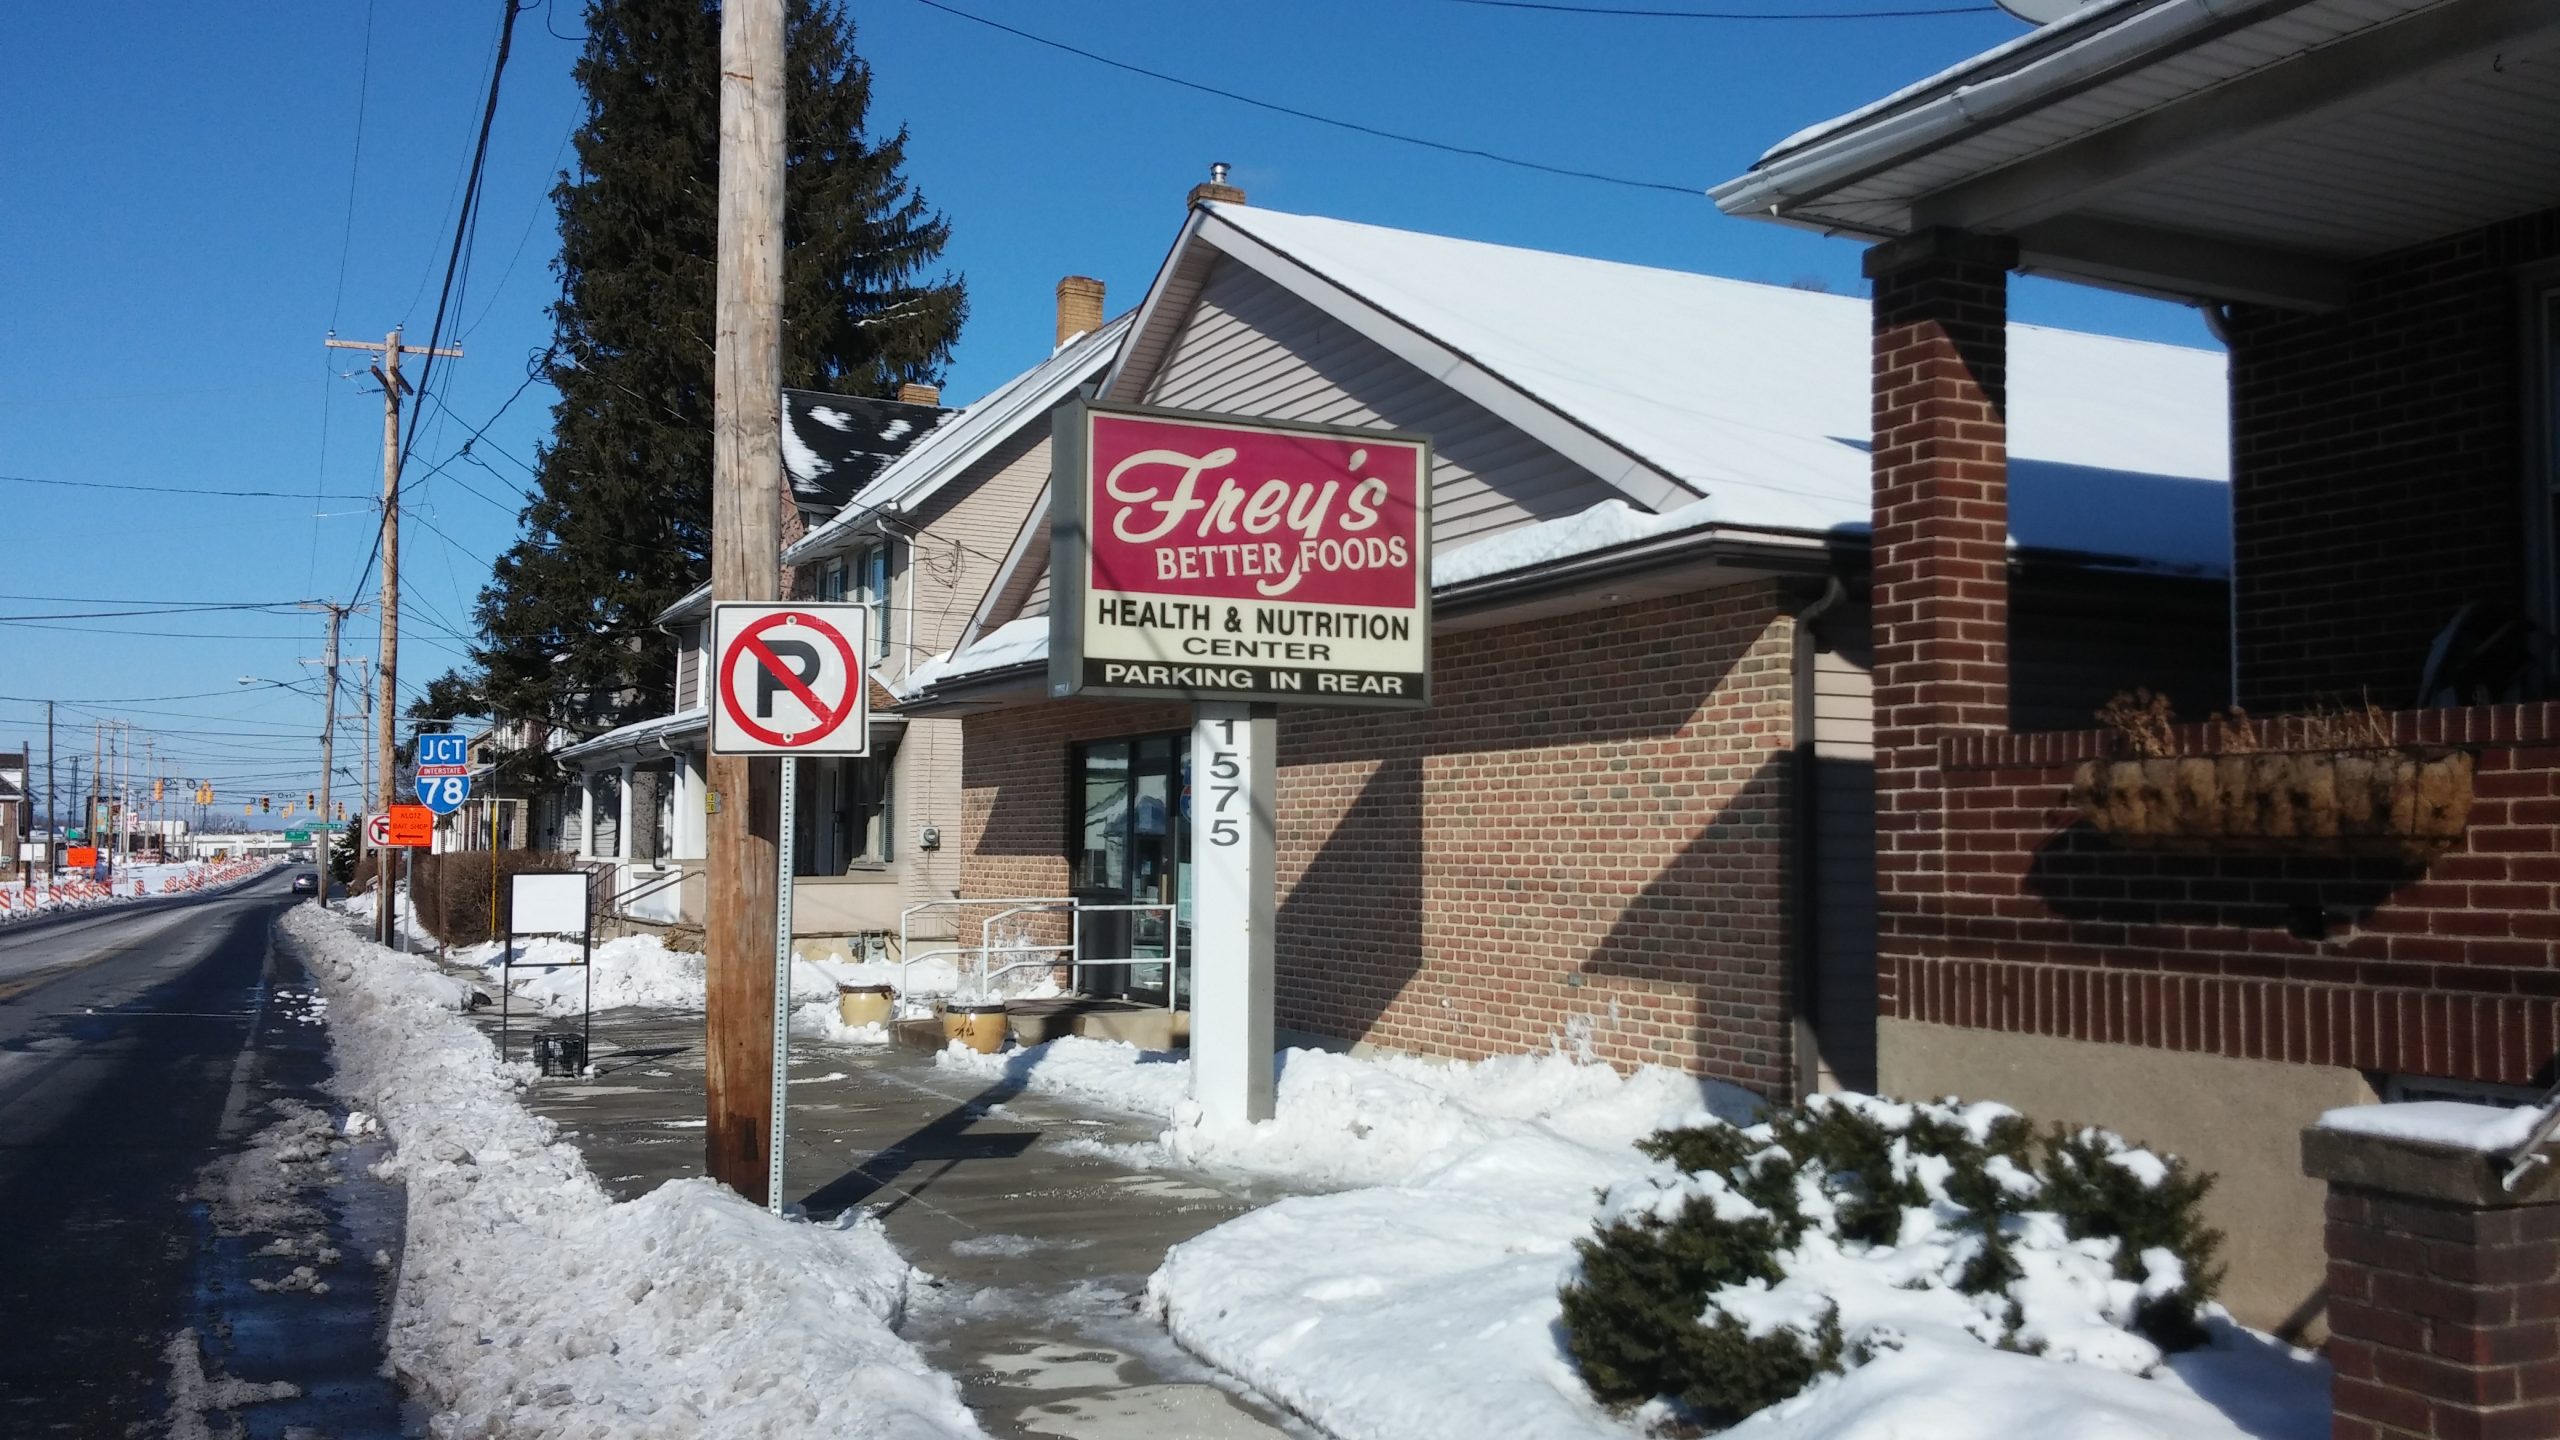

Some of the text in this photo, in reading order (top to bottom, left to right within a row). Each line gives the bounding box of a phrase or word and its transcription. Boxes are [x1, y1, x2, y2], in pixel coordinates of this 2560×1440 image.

[1106, 447, 1388, 596] Frey's
[1155, 535, 1408, 580] BETTER FOODS
[1098, 598, 1409, 641] HEALTH & NUTRITION
[1182, 636, 1331, 662] CENTER
[1104, 664, 1403, 695] PARKING IN REAR
[422, 740, 463, 760] JCT
[424, 767, 461, 775] INTERSTATE
[421, 777, 463, 804] 78
